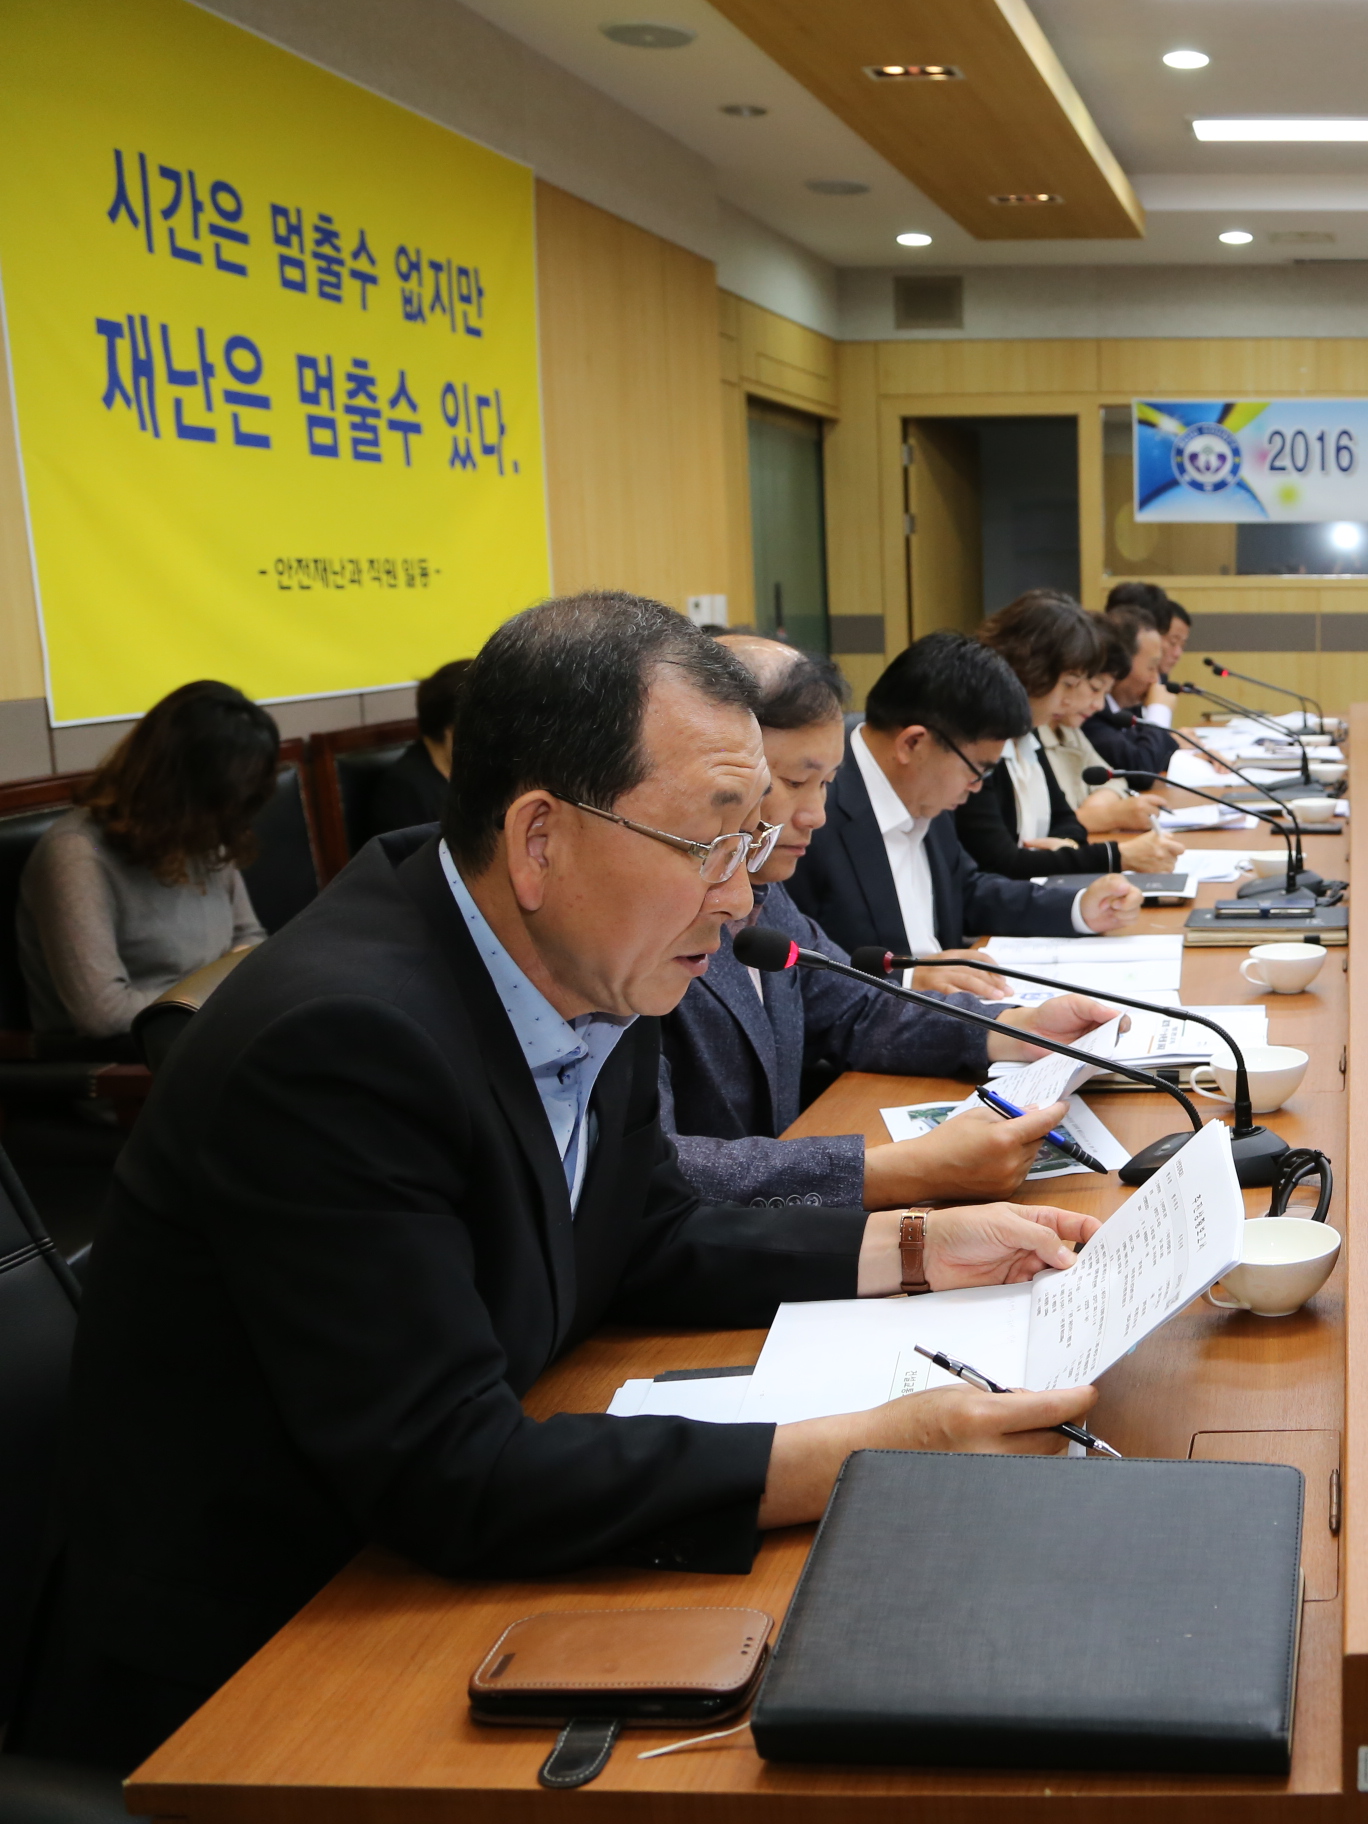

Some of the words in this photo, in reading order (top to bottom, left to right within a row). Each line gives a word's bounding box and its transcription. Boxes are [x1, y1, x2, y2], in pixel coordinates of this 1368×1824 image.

[107, 148, 250, 277] 시간은
[271, 203, 378, 310] 멈출수
[395, 244, 485, 338] 없지만
[95, 313, 272, 450] 재난은
[295, 353, 422, 467] 멈출수
[441, 381, 520, 476] 있다.
[1267, 430, 1356, 474] 2016
[367, 557, 399, 590] 직원
